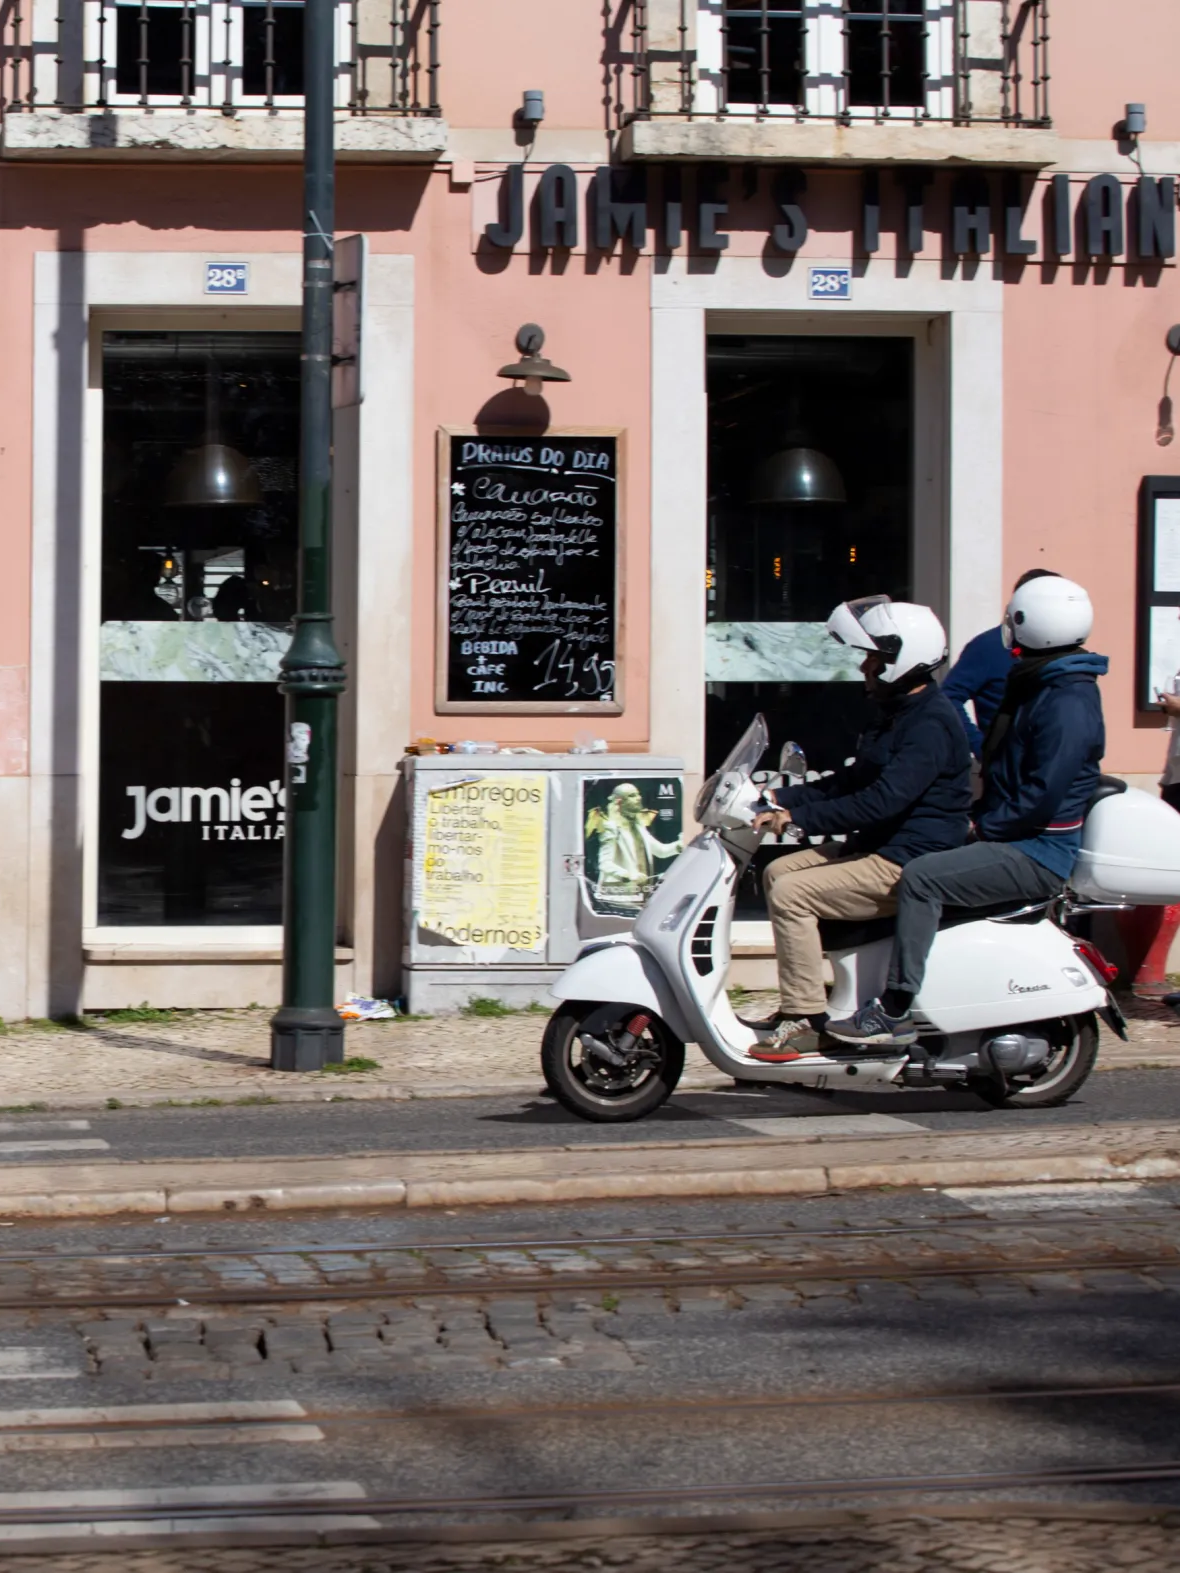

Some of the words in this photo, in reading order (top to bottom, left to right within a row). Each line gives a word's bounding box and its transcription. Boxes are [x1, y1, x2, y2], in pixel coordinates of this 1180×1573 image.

[484, 163, 808, 251] JAMIE'S
[863, 167, 1175, 258] ITALIAN
[540, 447, 565, 467] DO
[572, 450, 611, 470] DIA
[460, 640, 519, 655] BEBIDA
[430, 801, 485, 815] Libertar
[428, 817, 438, 828] o
[201, 825, 286, 841] ITALIA
[427, 845, 483, 856] mo-nos
[425, 869, 484, 883] trabalho
